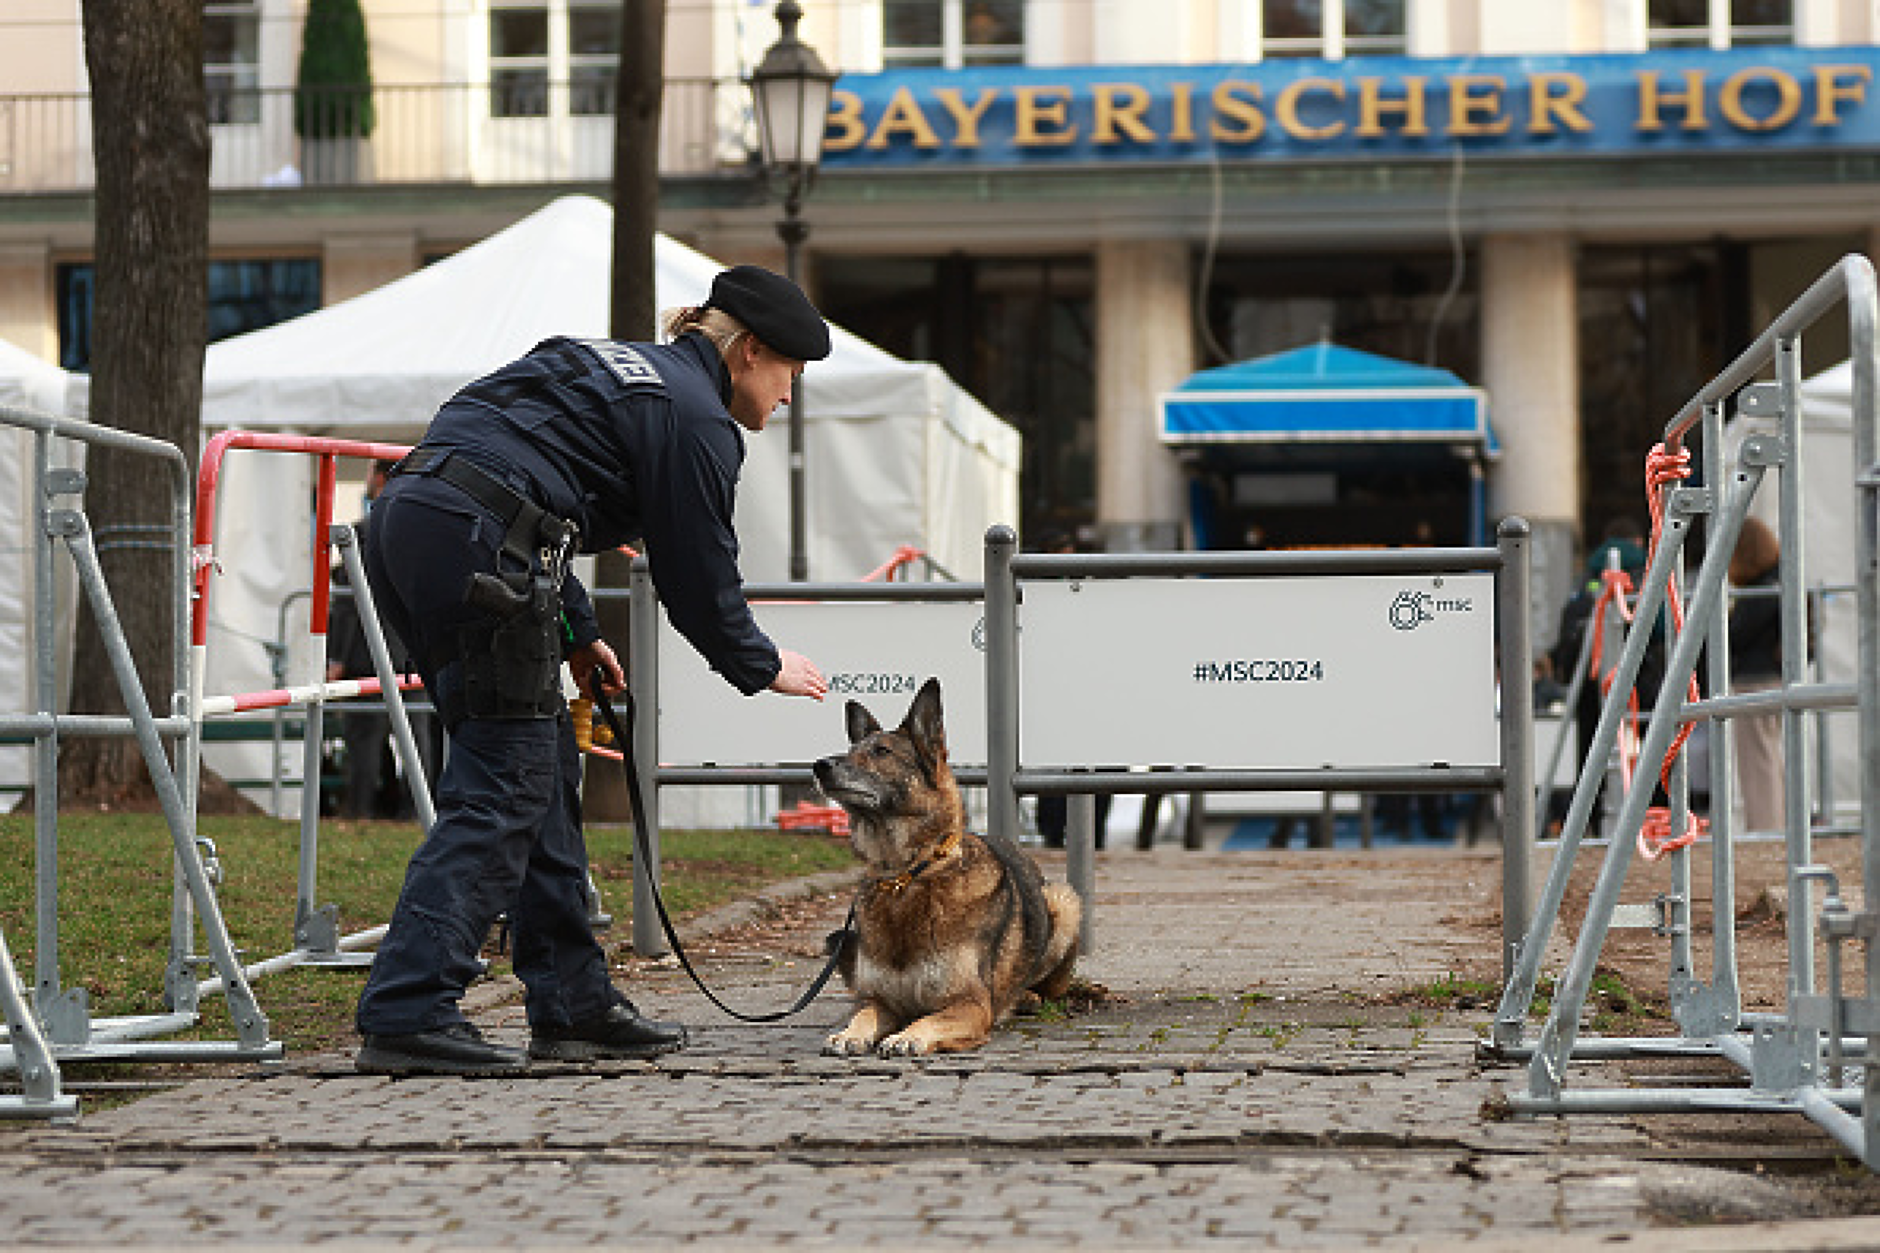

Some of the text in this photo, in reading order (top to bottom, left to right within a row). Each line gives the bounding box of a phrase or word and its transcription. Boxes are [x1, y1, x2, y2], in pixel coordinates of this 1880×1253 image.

[822, 64, 1873, 150] BAYERISCHER HOF
[1436, 599, 1473, 612] msc
[1192, 660, 1324, 682] #MSC2024
